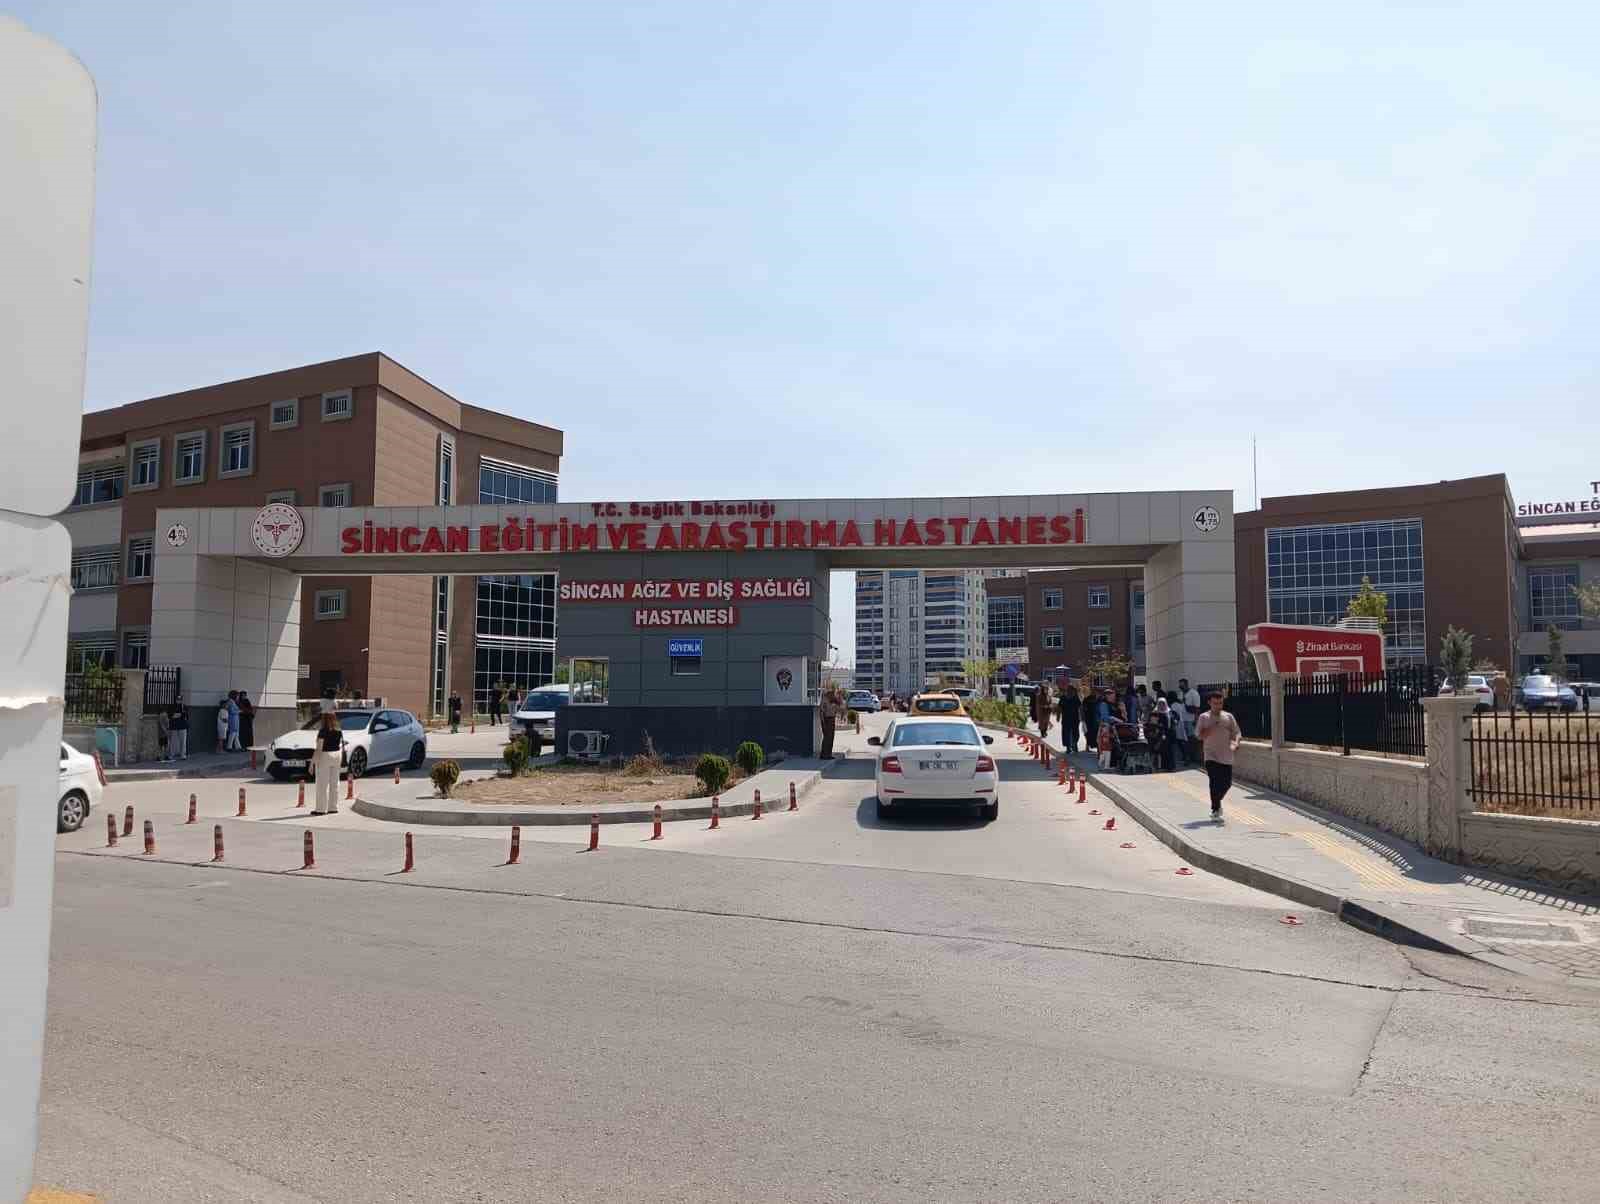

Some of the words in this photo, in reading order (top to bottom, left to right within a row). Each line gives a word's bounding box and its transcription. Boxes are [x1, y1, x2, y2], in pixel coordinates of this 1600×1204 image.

[592, 503, 622, 518] T.C.
[630, 502, 684, 520] Sağlık
[692, 500, 775, 519] Bakanlığı
[1518, 502, 1575, 515] SİNCAN
[1195, 512, 1206, 525] 4
[341, 520, 469, 553] SİNCAN
[480, 517, 598, 551] EĞİTİM
[607, 523, 648, 550] VE
[655, 519, 864, 553] ARAŞTIRMA
[875, 508, 1084, 545] HASTANESİ
[560, 581, 624, 599] SİNCAN
[632, 580, 671, 598] AĞIZ
[678, 582, 699, 597] VE
[706, 579, 733, 600] DİŞ
[741, 577, 810, 597] SAĞLIĞI
[635, 606, 733, 625] HASTANESİ
[1305, 641, 1329, 651] Ziraat
